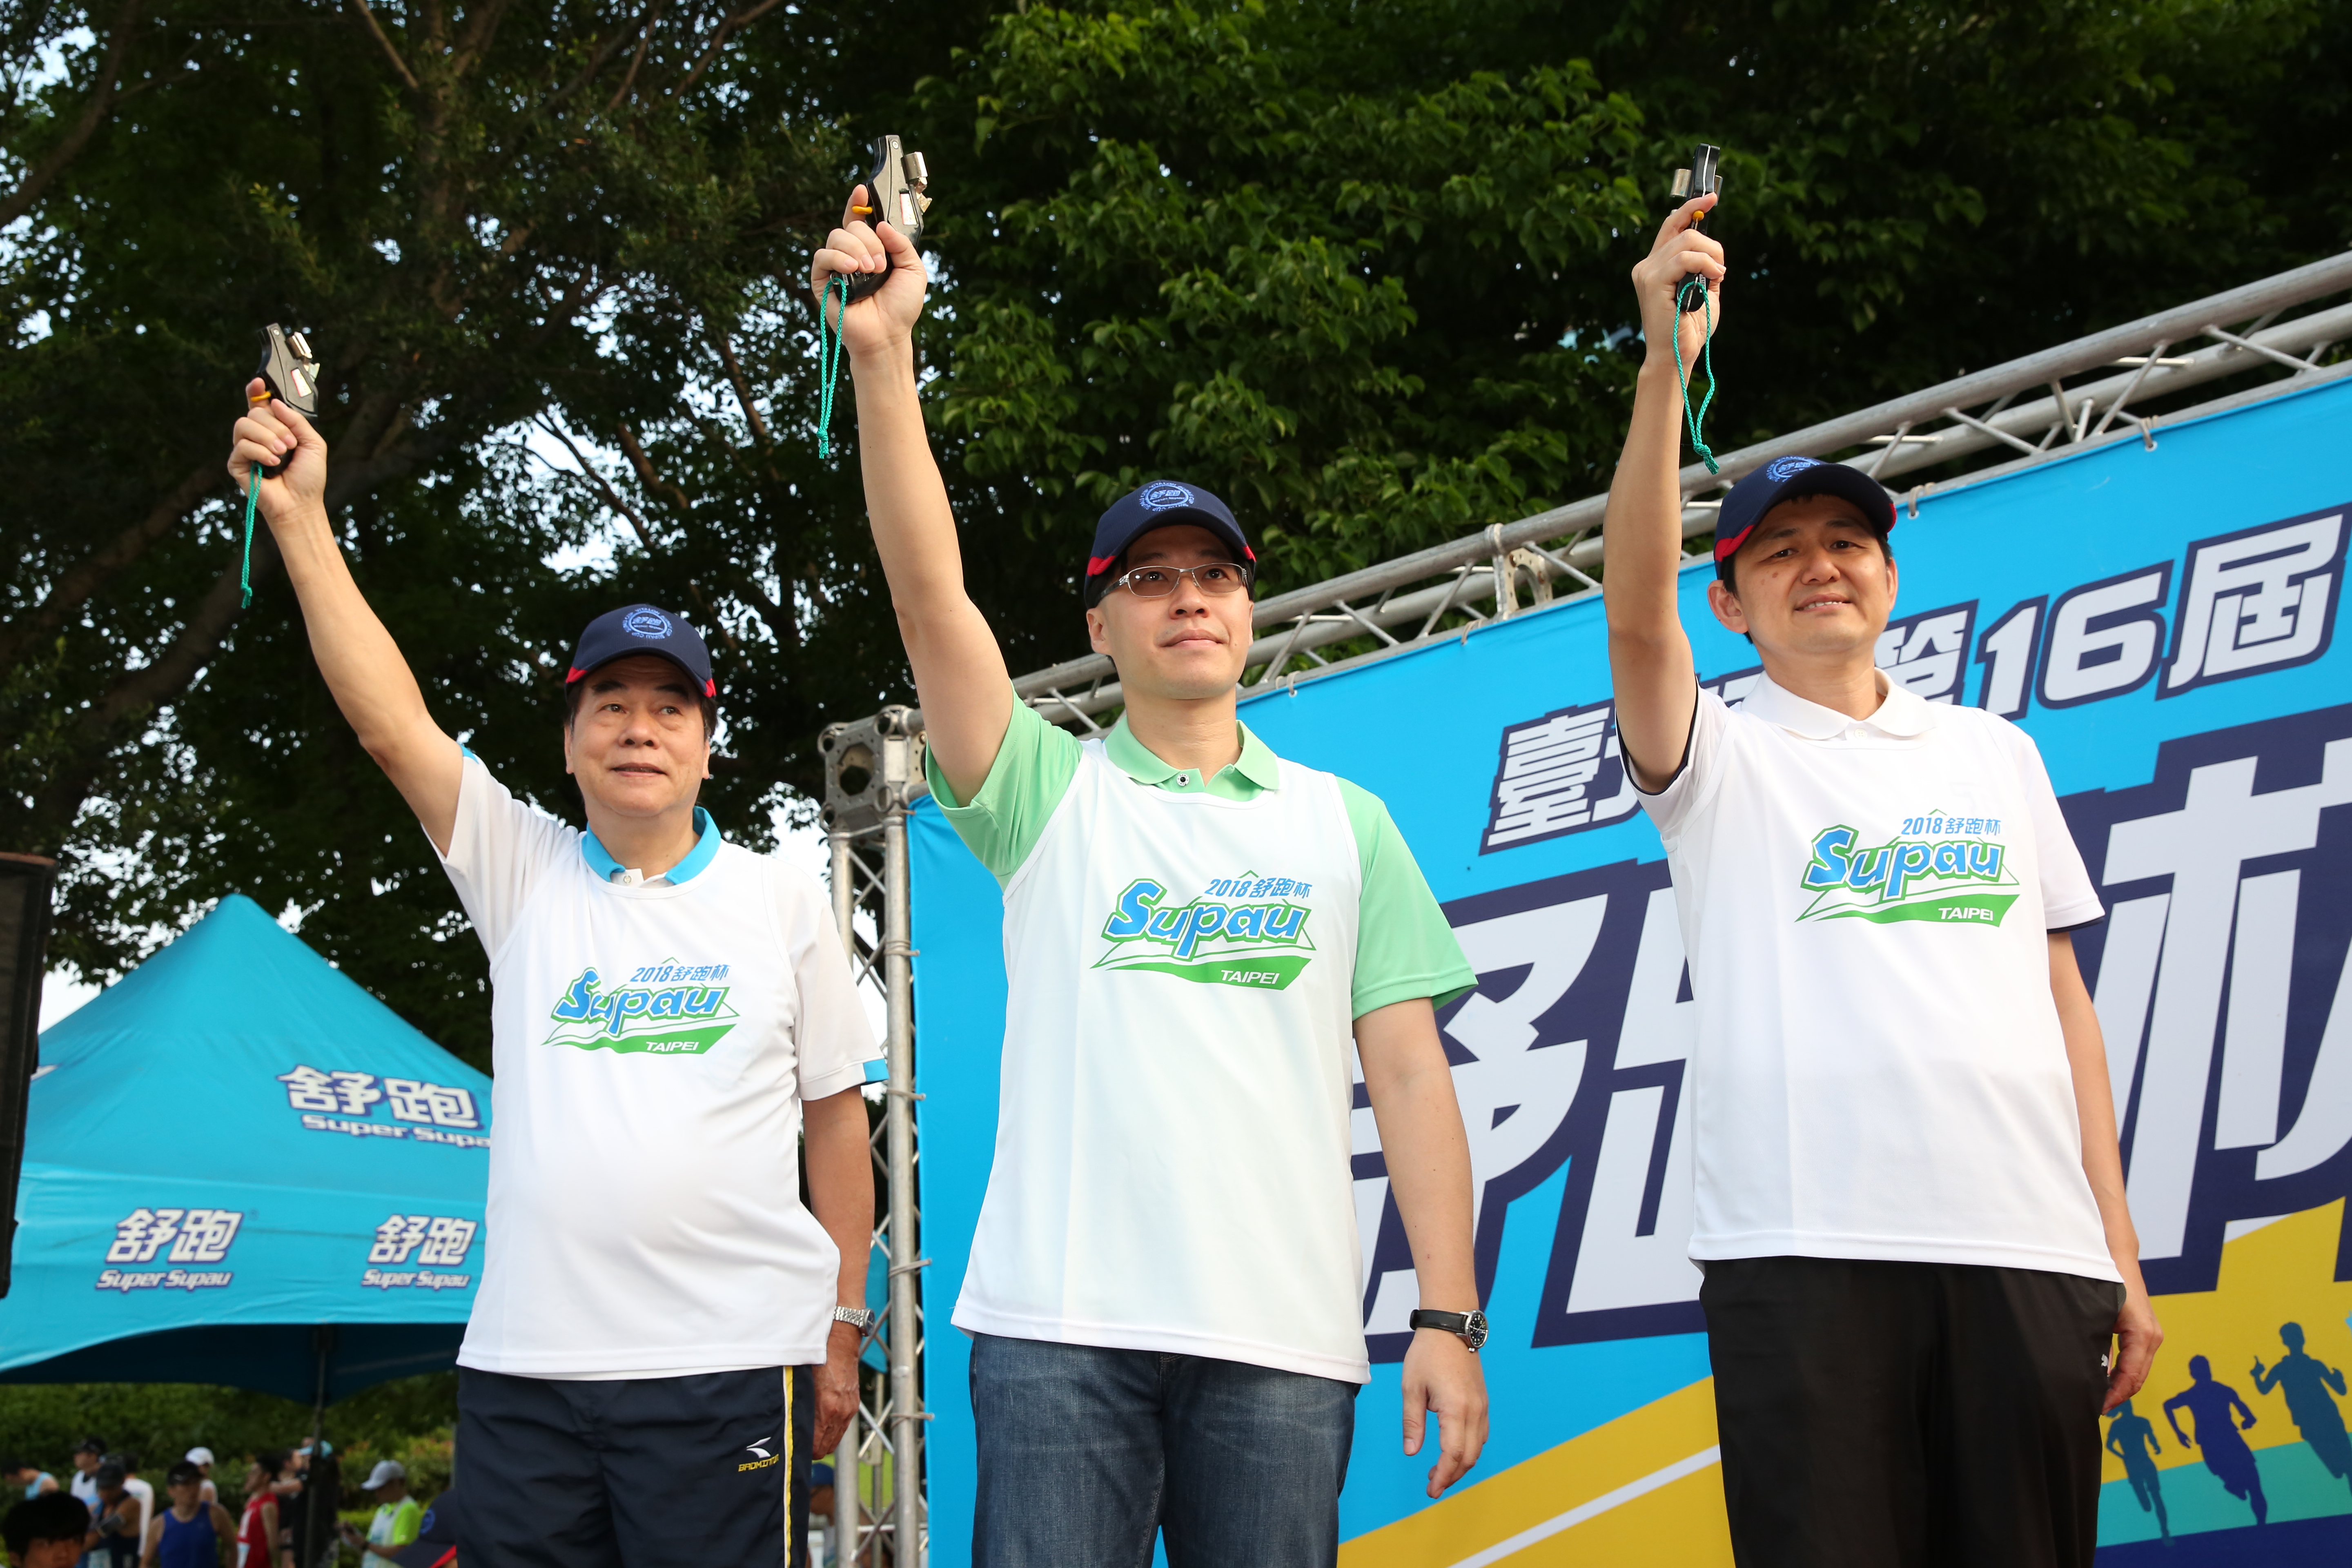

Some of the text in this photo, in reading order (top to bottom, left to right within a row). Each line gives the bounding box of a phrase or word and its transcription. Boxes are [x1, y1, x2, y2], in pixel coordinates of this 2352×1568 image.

[1805, 826, 2002, 899] Supau
[1105, 880, 1307, 960] Supau
[1938, 907, 1994, 921] TAIPEI
[1220, 969, 1281, 984] TAIPEI
[553, 968, 727, 1036] Supau
[645, 1041, 699, 1052] TAIPEI
[276, 1064, 480, 1129] 舒跑
[301, 1114, 408, 1136] Super
[105, 1208, 244, 1263] 舒跑
[368, 1214, 478, 1265] 舒跑
[95, 1269, 233, 1292] Super Supau
[361, 1268, 470, 1290] Super Supau
